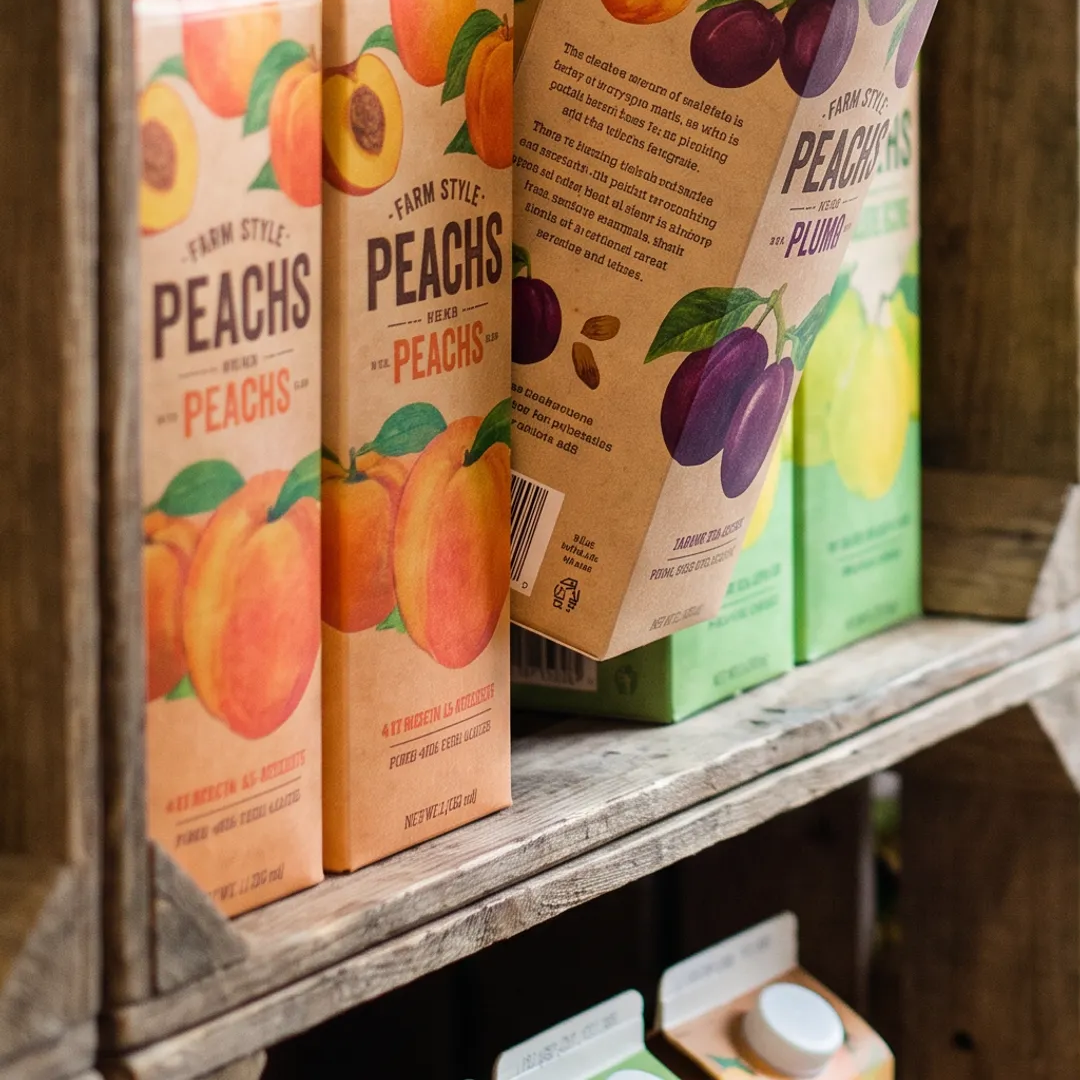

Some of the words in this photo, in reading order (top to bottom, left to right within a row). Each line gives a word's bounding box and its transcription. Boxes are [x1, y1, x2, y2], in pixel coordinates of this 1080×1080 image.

[669, 91, 682, 102] of
[733, 114, 744, 127] is
[828, 88, 863, 120] FARM
[728, 133, 740, 146] is
[781, 119, 890, 195] PEACHS
[394, 181, 435, 220] FARM
[440, 178, 481, 207] STYLE
[186, 221, 234, 264] FARM
[241, 218, 286, 248] STYLE
[655, 217, 668, 229] is
[367, 211, 503, 311] PEACHS
[583, 250, 606, 265] and
[153, 252, 311, 361] PEACHS
[393, 320, 484, 385] PEACHS
[183, 367, 291, 439] PEACHS
